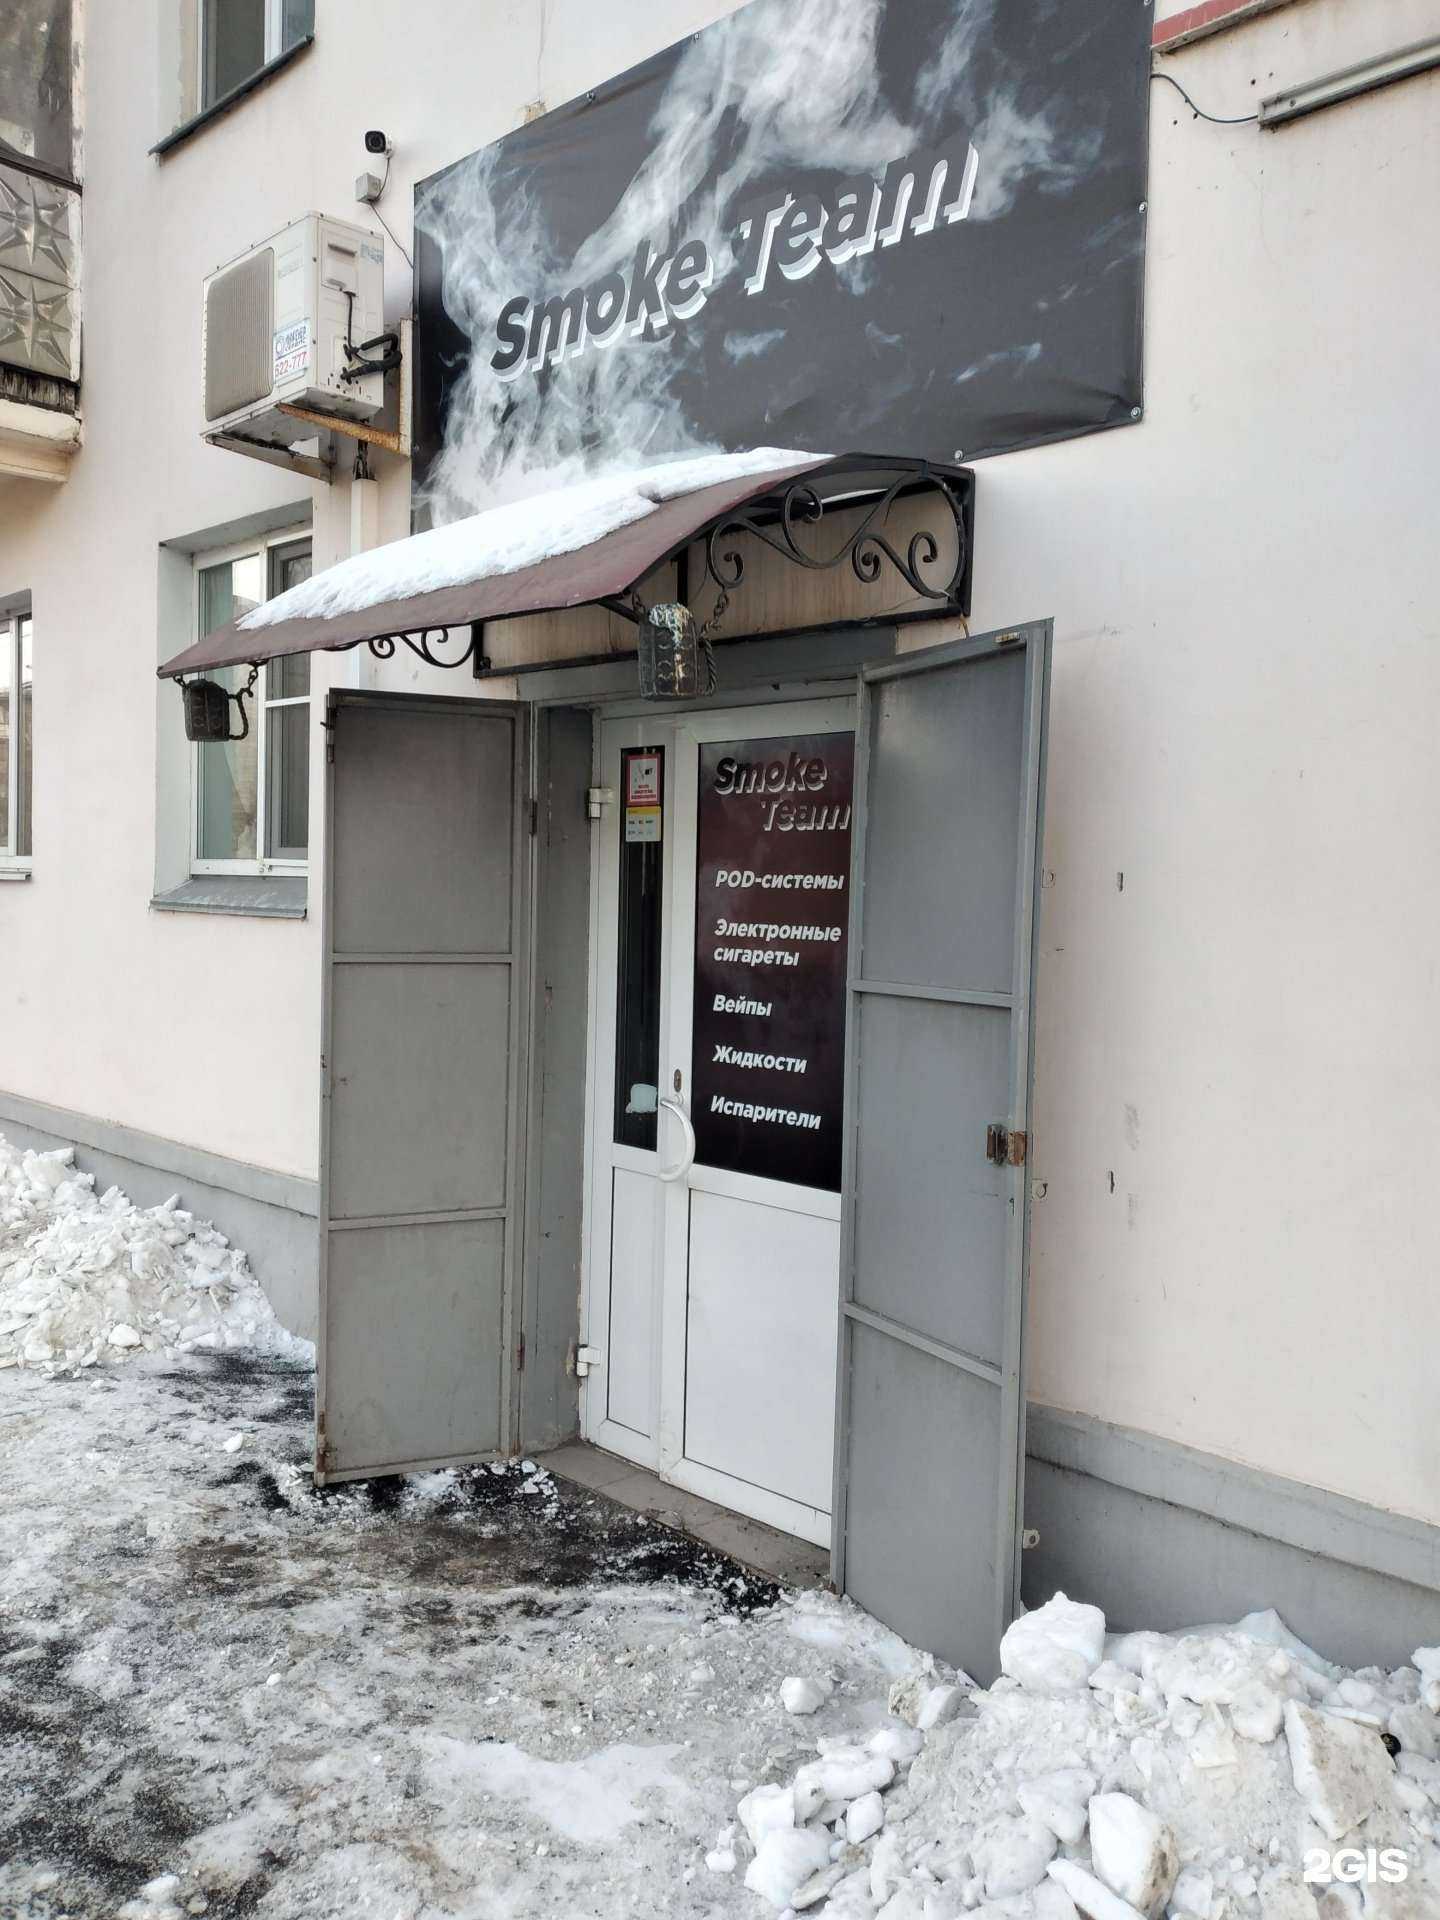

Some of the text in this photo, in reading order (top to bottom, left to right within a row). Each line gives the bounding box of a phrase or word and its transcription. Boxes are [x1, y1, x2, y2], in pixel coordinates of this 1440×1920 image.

[490, 140, 979, 383] Smoke Team
[714, 752, 827, 795] Smoke
[760, 796, 851, 832] Team
[715, 869, 845, 890] POD-системы
[714, 918, 842, 942] Электронные
[713, 946, 800, 966] сигареты
[713, 994, 772, 1017] Вейпы
[712, 1045, 808, 1073] Жидкости
[710, 1096, 822, 1130] Испарители
